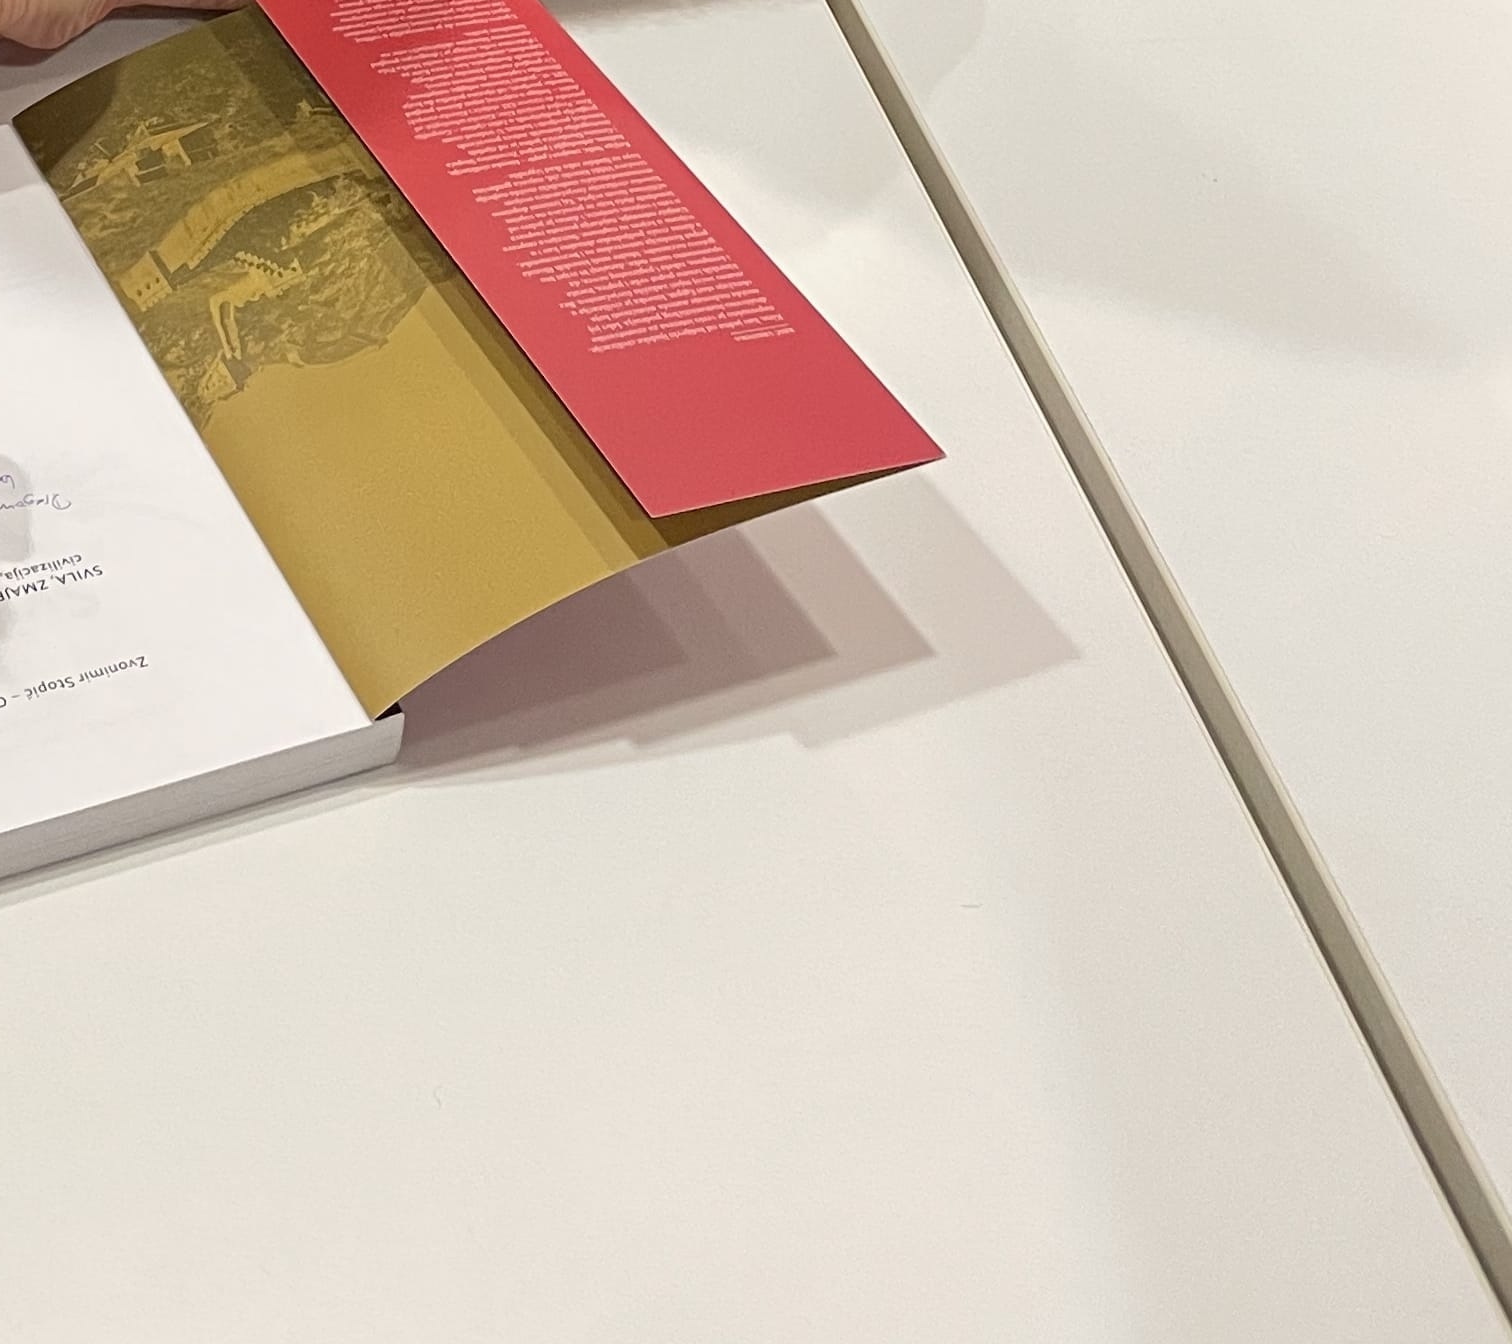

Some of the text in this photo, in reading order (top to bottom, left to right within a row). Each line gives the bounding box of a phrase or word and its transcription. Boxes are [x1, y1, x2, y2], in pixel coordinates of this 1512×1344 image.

[0, 554, 83, 581] civilizacija,
[49, 564, 104, 585] SVILA,
[78, 655, 149, 683] Zvonimir
[23, 676, 76, 701] Stopić
